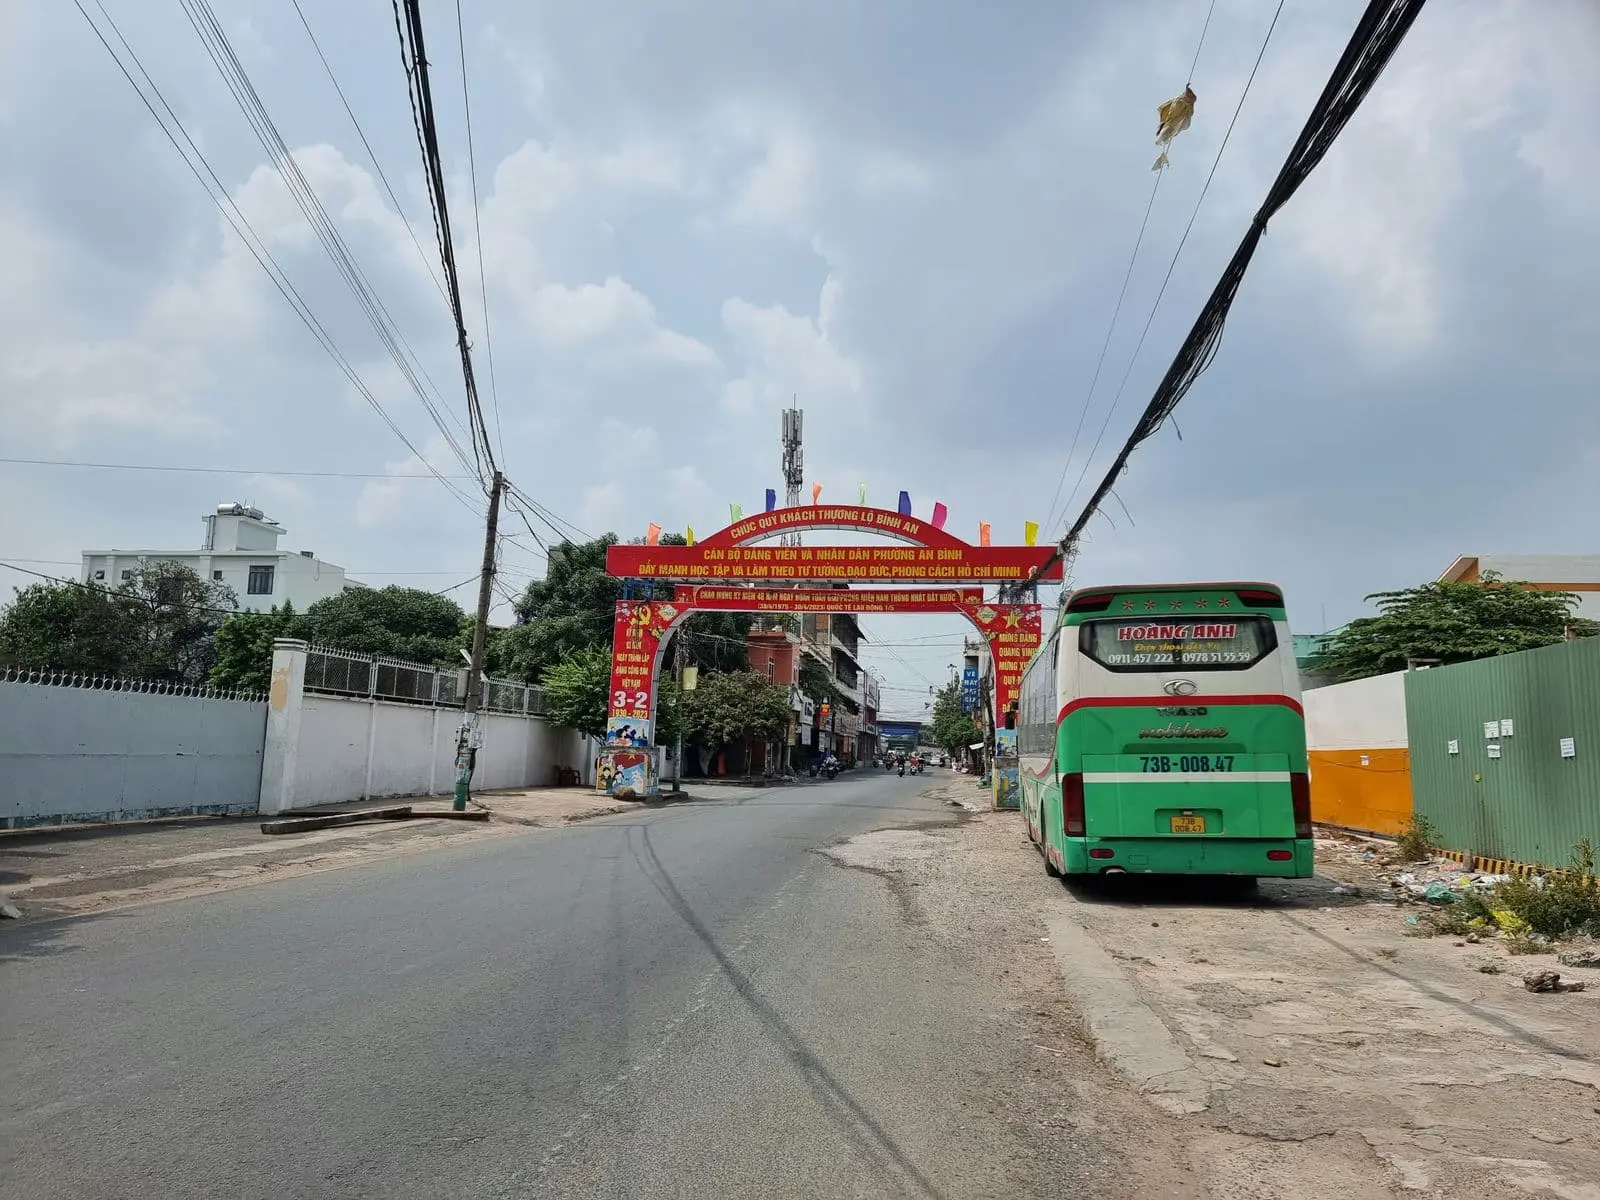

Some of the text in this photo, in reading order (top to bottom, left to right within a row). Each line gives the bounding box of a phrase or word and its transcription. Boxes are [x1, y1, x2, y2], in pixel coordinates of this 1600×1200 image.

[730, 509, 920, 538] CHÚC QUÝ KHÁCH THƯỢNG LỘ BÌNH AN
[704, 547, 962, 562] CÁN BỘ ĐẢNG VIÊN VÀ NHÂN DÂN PHƯỜNG AN BÌNH
[659, 565, 688, 578] MẠNH
[690, 565, 709, 578] HỌC
[712, 563, 730, 578] TẬP
[732, 564, 744, 575] VÀ
[746, 564, 768, 576] LÀM
[770, 565, 794, 576] THEO
[797, 565, 811, 576] TƯ
[928, 564, 955, 577] CÁCH
[958, 562, 972, 577] HỒ
[974, 564, 991, 577] CHÍ
[993, 566, 1020, 577] MINH
[826, 602, 842, 611] QUỐC
[844, 603, 852, 611] TẾ
[1118, 623, 1236, 640] HOÀNG ANH
[1108, 654, 1130, 664] 0911
[1133, 654, 1151, 664] 457
[1154, 654, 1174, 663] 222
[1182, 652, 1208, 663] 0978
[613, 690, 647, 708] 3-2
[613, 708, 627, 718] 1930
[632, 710, 648, 719] 2023
